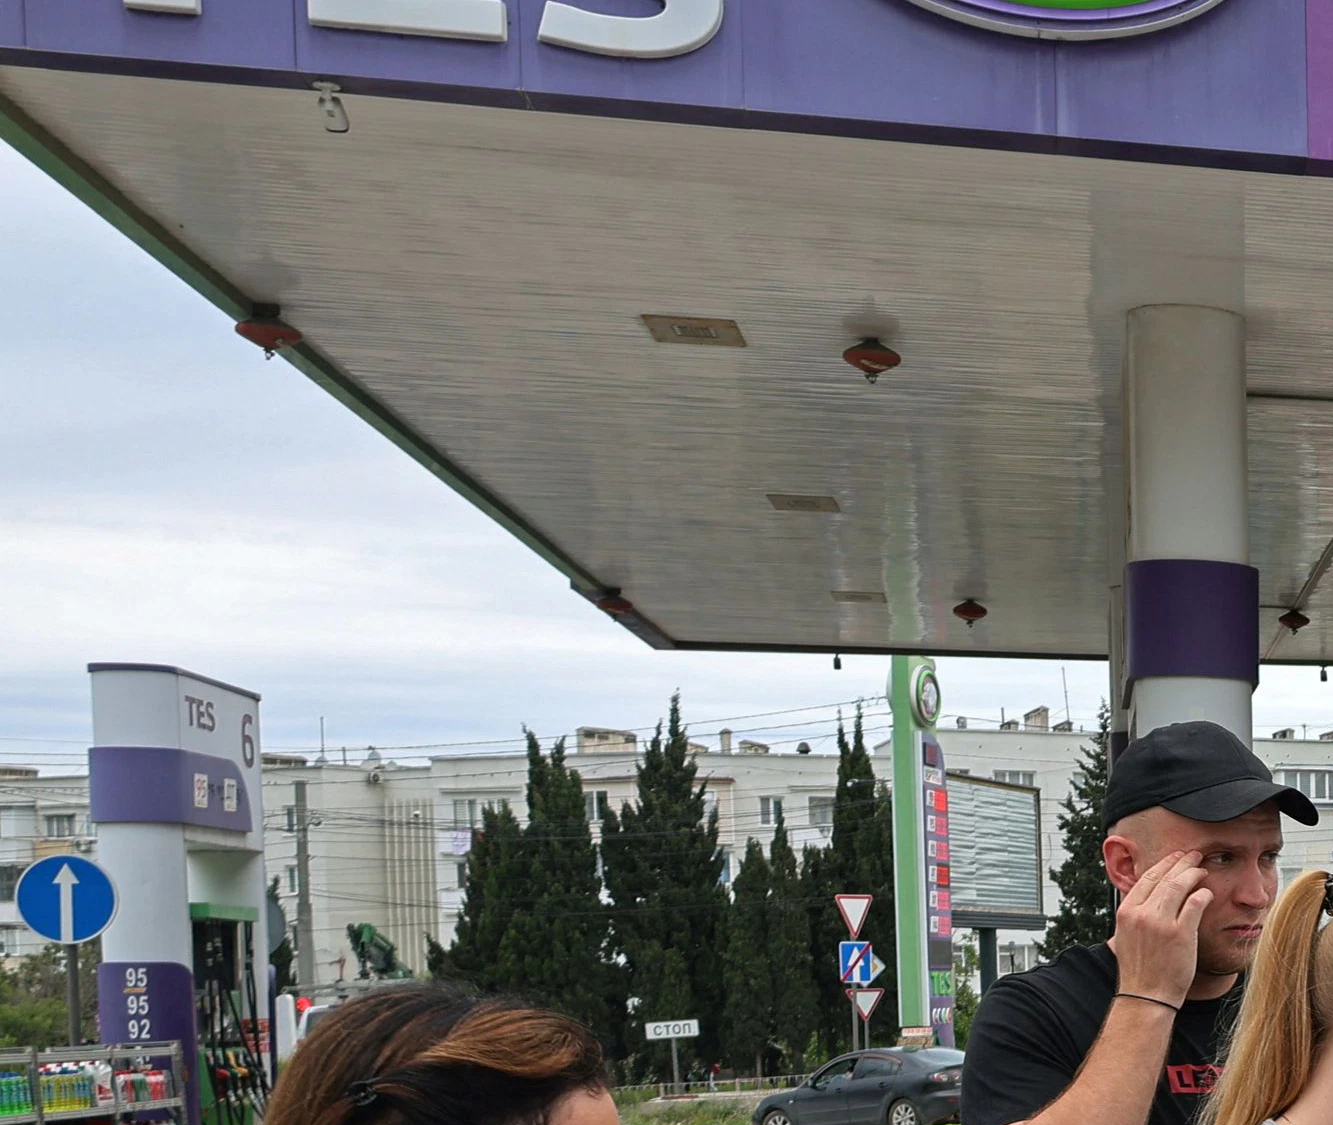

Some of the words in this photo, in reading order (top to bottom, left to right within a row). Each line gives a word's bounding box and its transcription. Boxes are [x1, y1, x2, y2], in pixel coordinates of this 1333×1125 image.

[185, 695, 215, 732] TES
[241, 714, 254, 768] 6
[125, 967, 148, 988] 95
[127, 995, 149, 1015] 95
[128, 1019, 151, 1039] 92
[653, 1022, 692, 1036] СТОП
